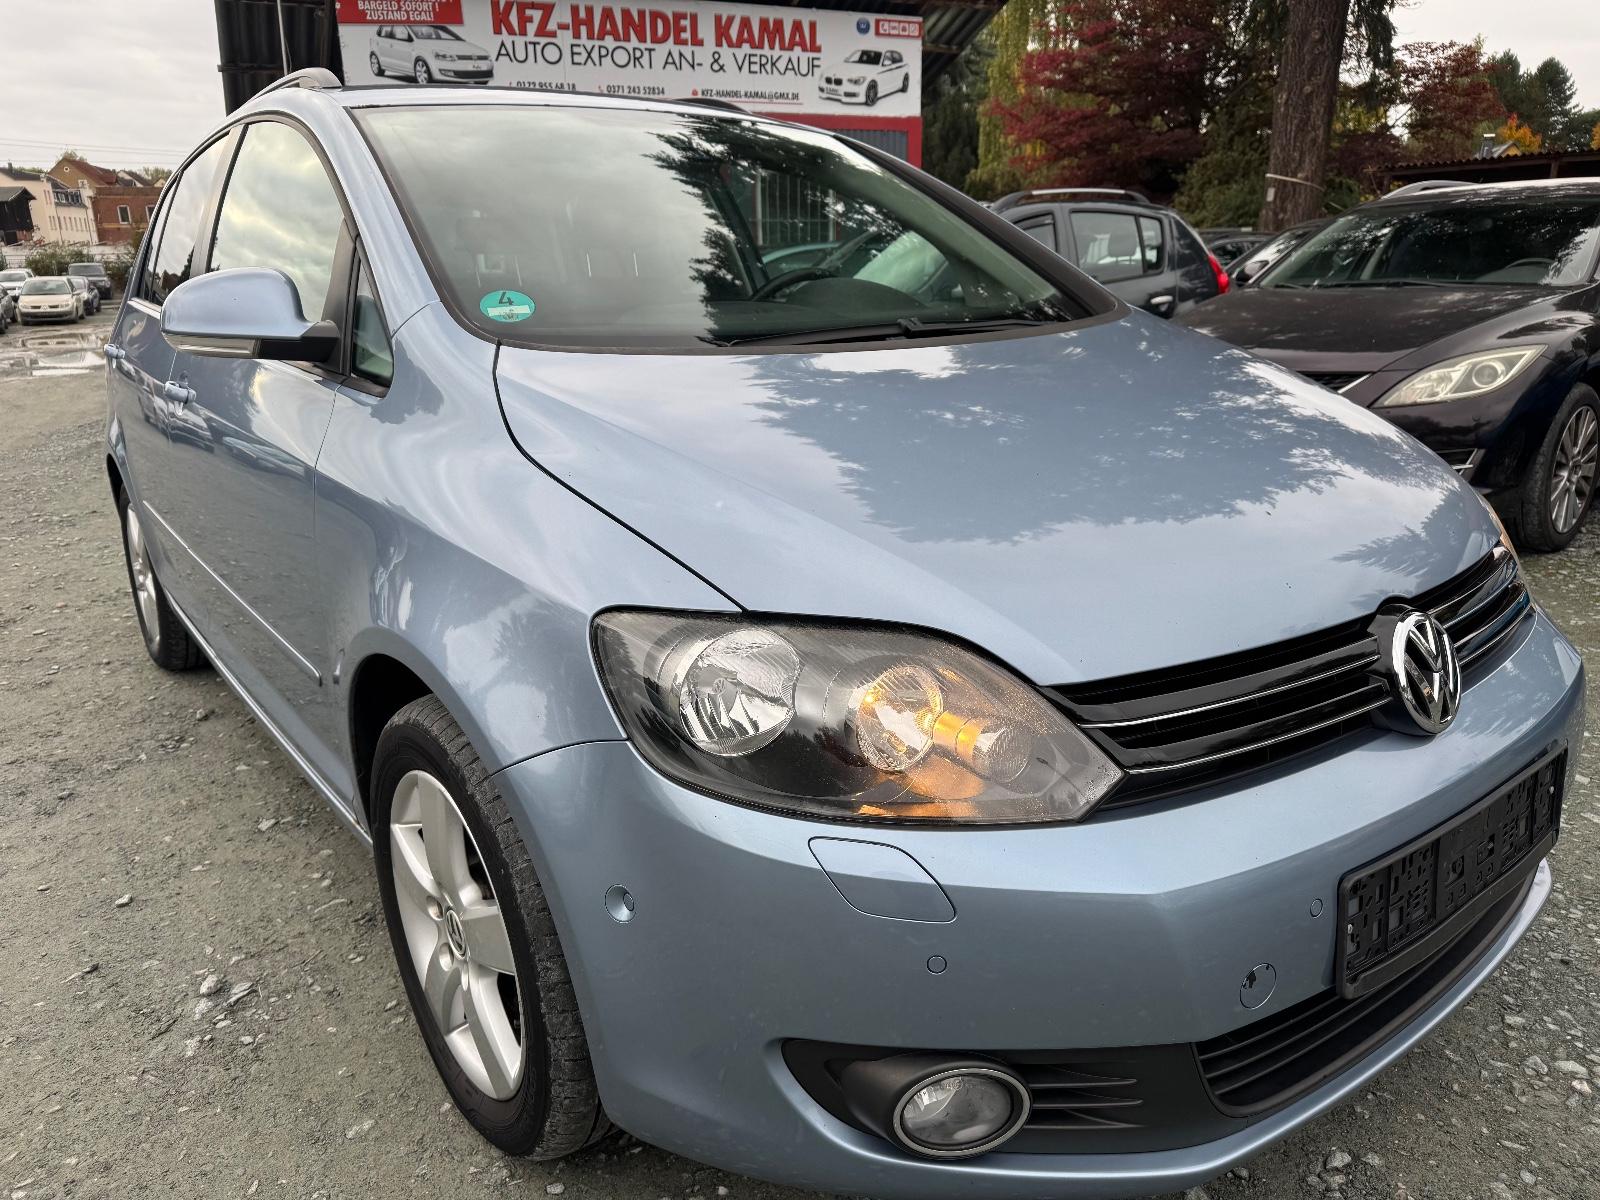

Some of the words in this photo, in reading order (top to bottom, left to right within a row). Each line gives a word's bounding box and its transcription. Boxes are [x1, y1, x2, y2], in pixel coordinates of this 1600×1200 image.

[358, 1, 398, 10] BARGELD
[400, 2, 433, 11] SOFORT
[366, 10, 408, 20] ZUSTAND
[410, 11, 434, 21] EGAL!
[490, 0, 704, 47] KFZ-HANDEL
[714, 12, 822, 53] KAMAL
[495, 40, 563, 65] AUTO
[570, 43, 656, 69] EXPORT
[662, 48, 703, 71] AN-
[710, 51, 727, 73] &
[733, 52, 821, 77] VERKAUF
[606, 84, 625, 94] 0371
[627, 85, 641, 95] 243
[498, 291, 514, 306] 4
